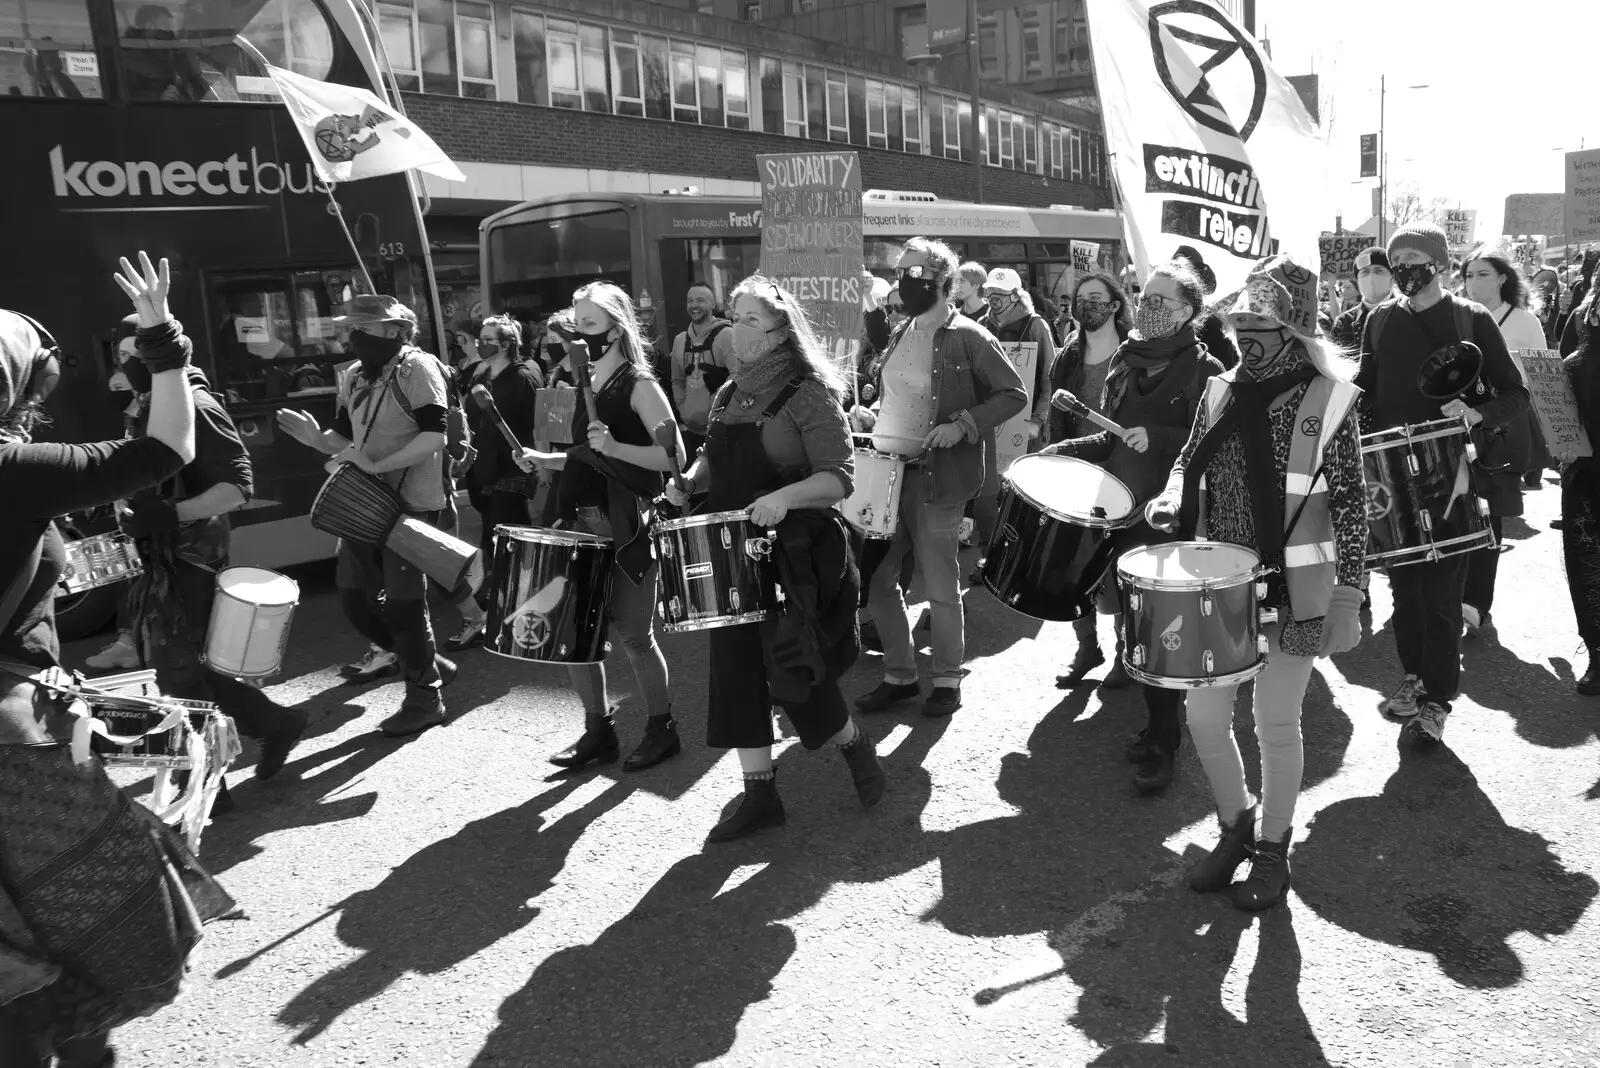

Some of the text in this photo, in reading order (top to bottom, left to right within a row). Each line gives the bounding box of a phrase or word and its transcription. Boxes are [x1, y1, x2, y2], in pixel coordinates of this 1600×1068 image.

[765, 155, 854, 190] SOLIDARITY
[729, 211, 753, 228] First
[863, 213, 897, 228] frequent
[898, 213, 915, 226] links
[1447, 211, 1467, 222] KILL
[1445, 222, 1468, 232] THE
[379, 242, 405, 256] 613
[1073, 247, 1094, 257] KILL
[1073, 254, 1090, 265] THE
[769, 276, 861, 305] OTESTERS
[1287, 285, 1310, 301] EBEL
